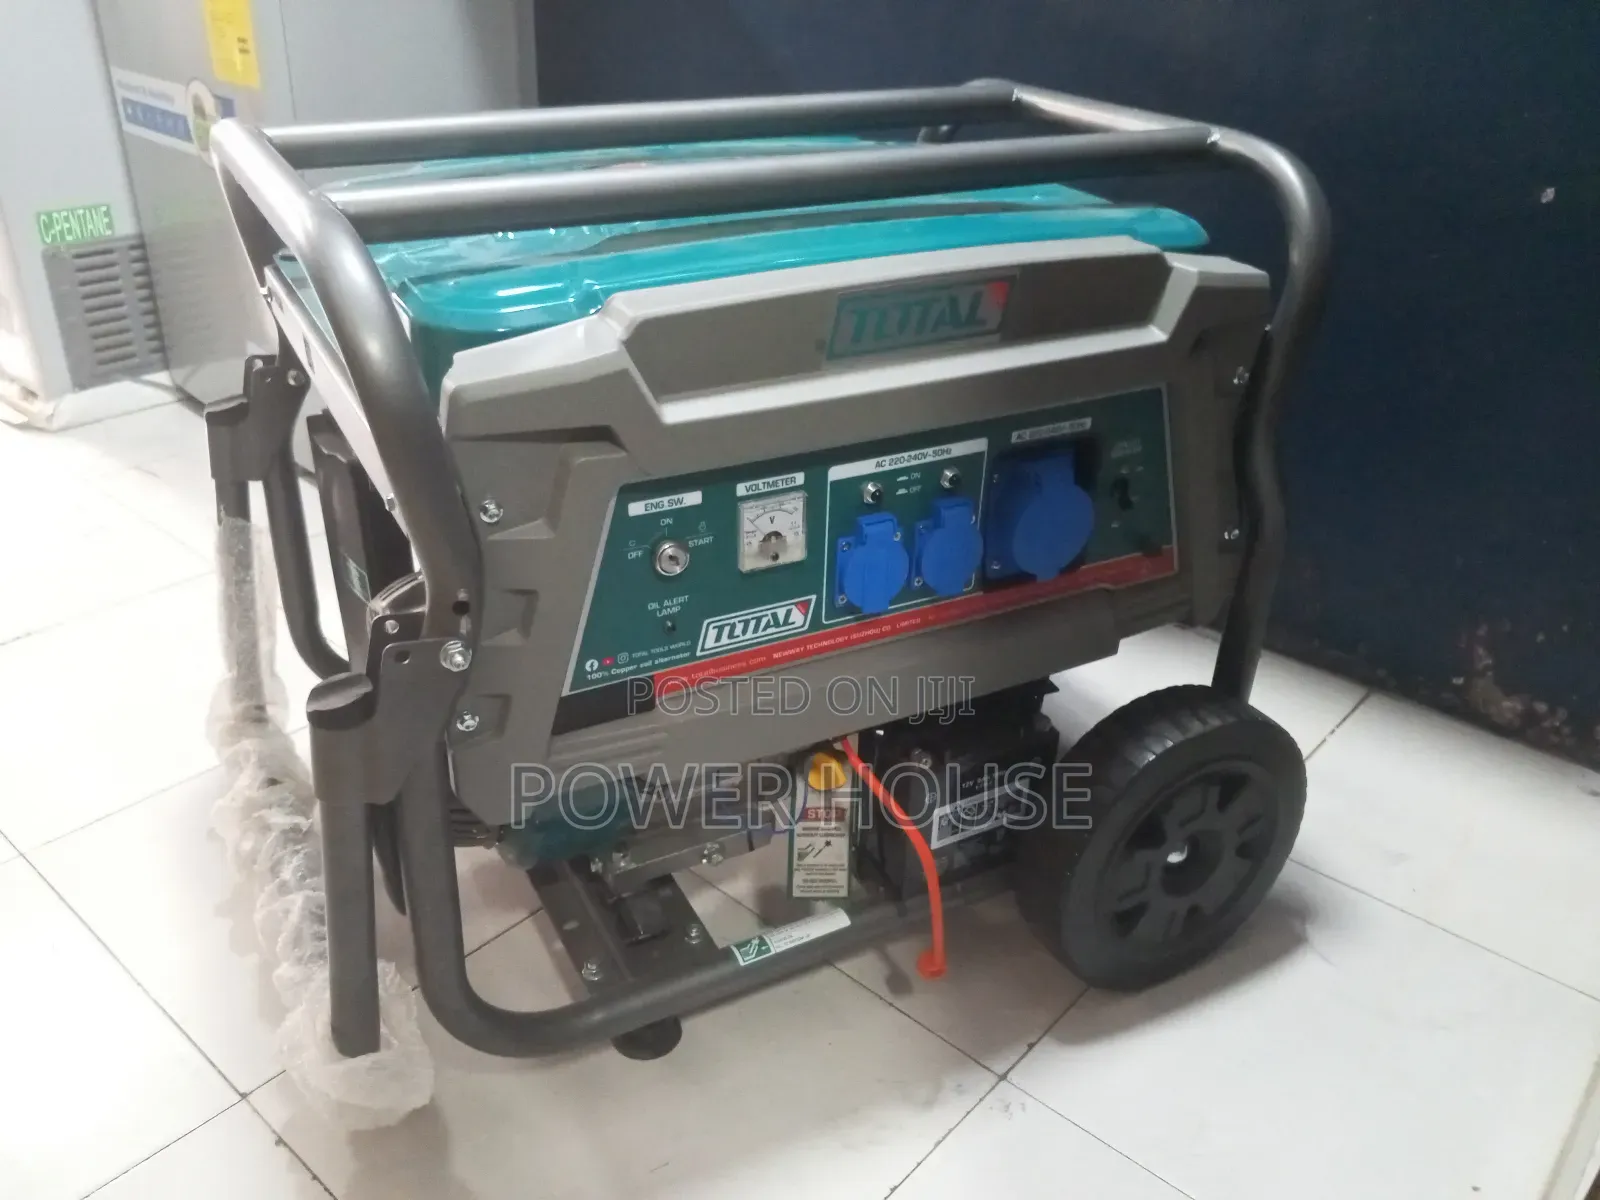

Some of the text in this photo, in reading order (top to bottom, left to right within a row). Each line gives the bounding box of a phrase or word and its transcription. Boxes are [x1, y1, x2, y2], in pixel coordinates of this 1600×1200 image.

[40, 205, 112, 243] C-PENTANE
[874, 460, 887, 469] AC
[910, 472, 921, 480] ON
[744, 475, 797, 494] VOLTMETER
[644, 496, 687, 512] ENG SW.
[660, 518, 673, 526] ON
[769, 515, 776, 525] V
[688, 536, 714, 548] START
[627, 550, 644, 560] OFF
[647, 594, 690, 611] OIL ALERT
[656, 605, 682, 618] LAMP
[711, 608, 797, 644] TOTAL
[806, 636, 849, 651] TECHNOLOGY
[610, 663, 638, 675] Copper
[807, 808, 842, 820] STOP
